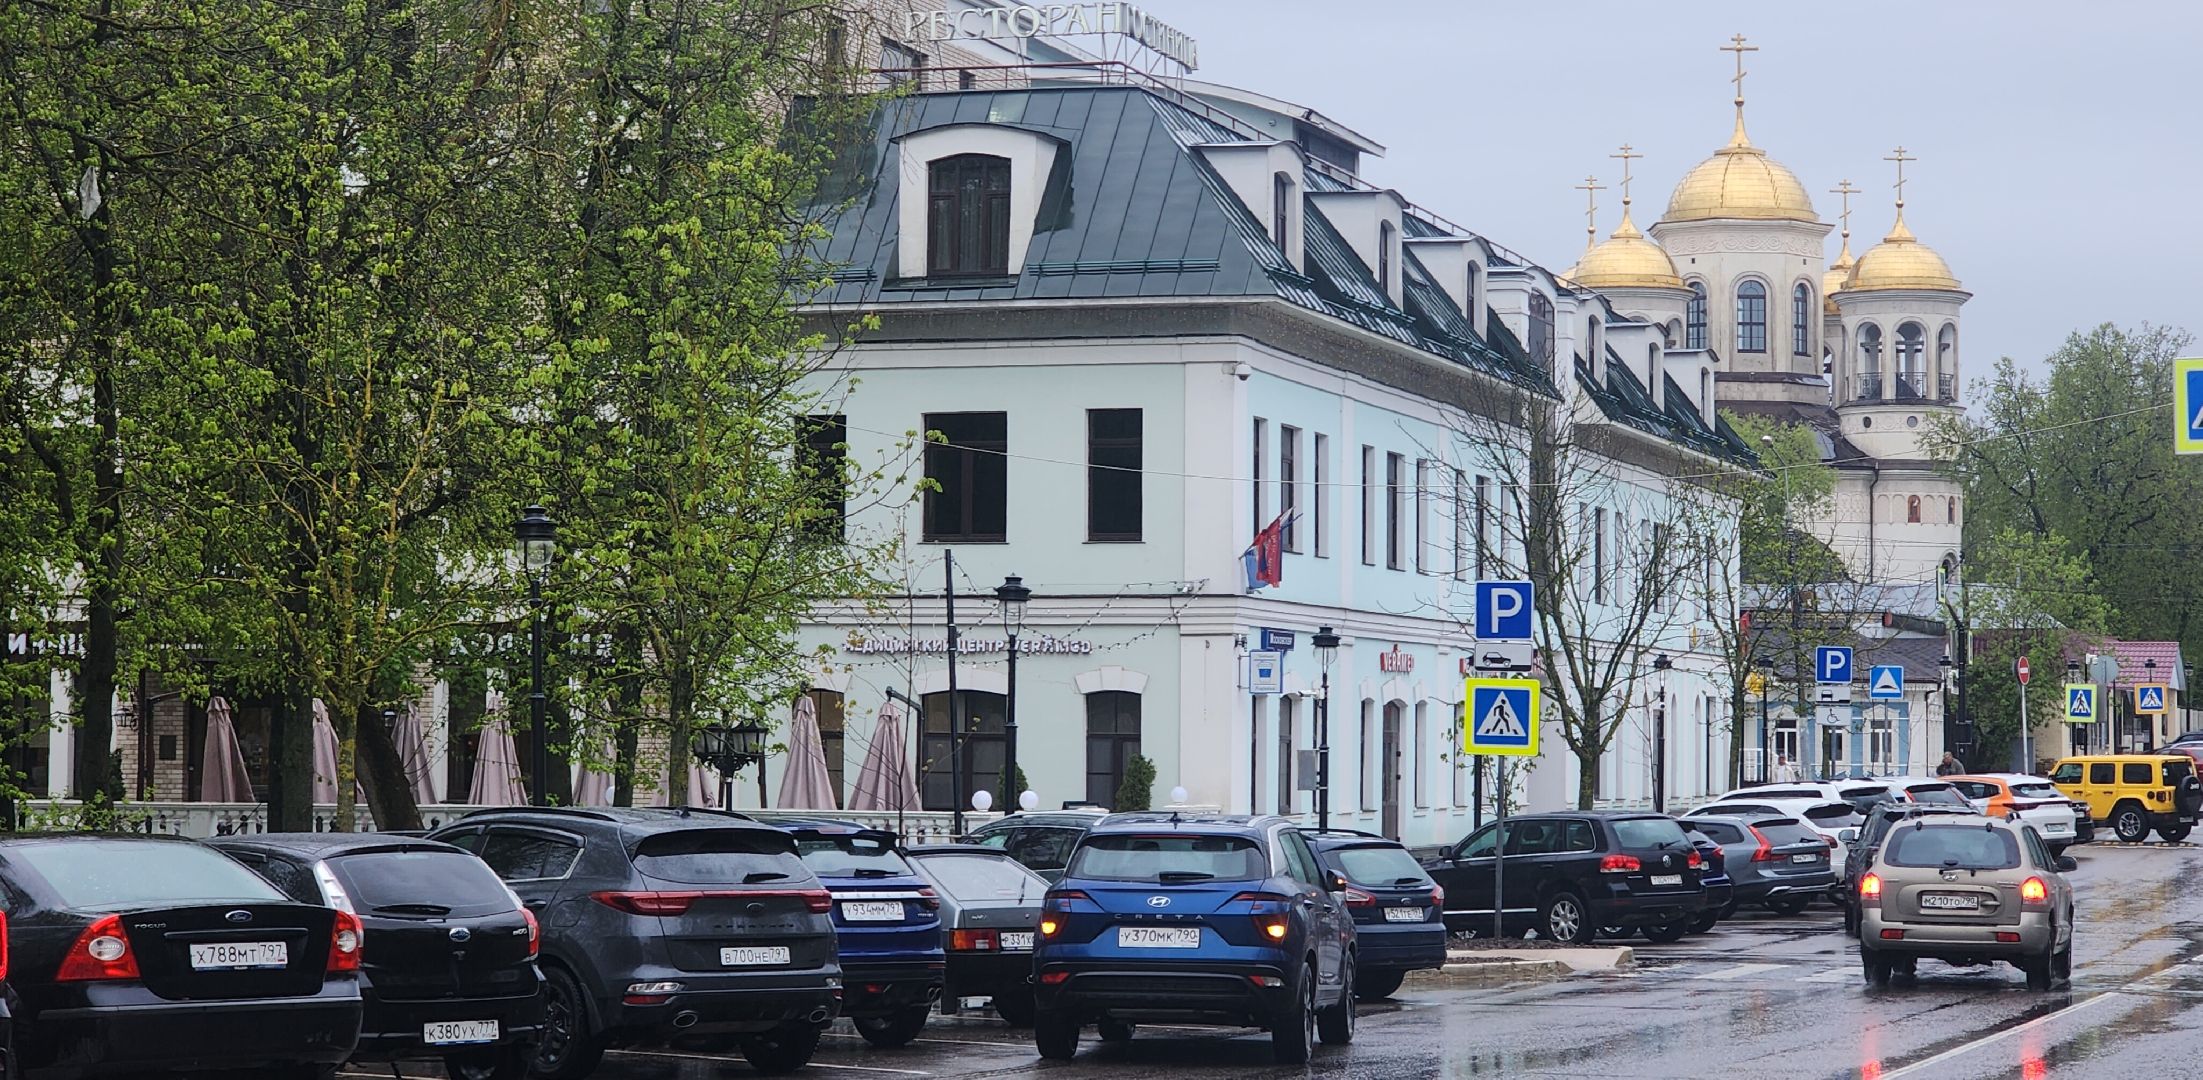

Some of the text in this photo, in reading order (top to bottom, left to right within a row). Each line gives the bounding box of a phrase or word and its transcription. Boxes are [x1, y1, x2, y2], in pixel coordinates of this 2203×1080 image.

[904, 2, 1122, 42] РЕСТОРАН
[1490, 588, 1523, 634] P
[956, 638, 1005, 654] ЦЕНТР
[1825, 650, 1846, 679] P
